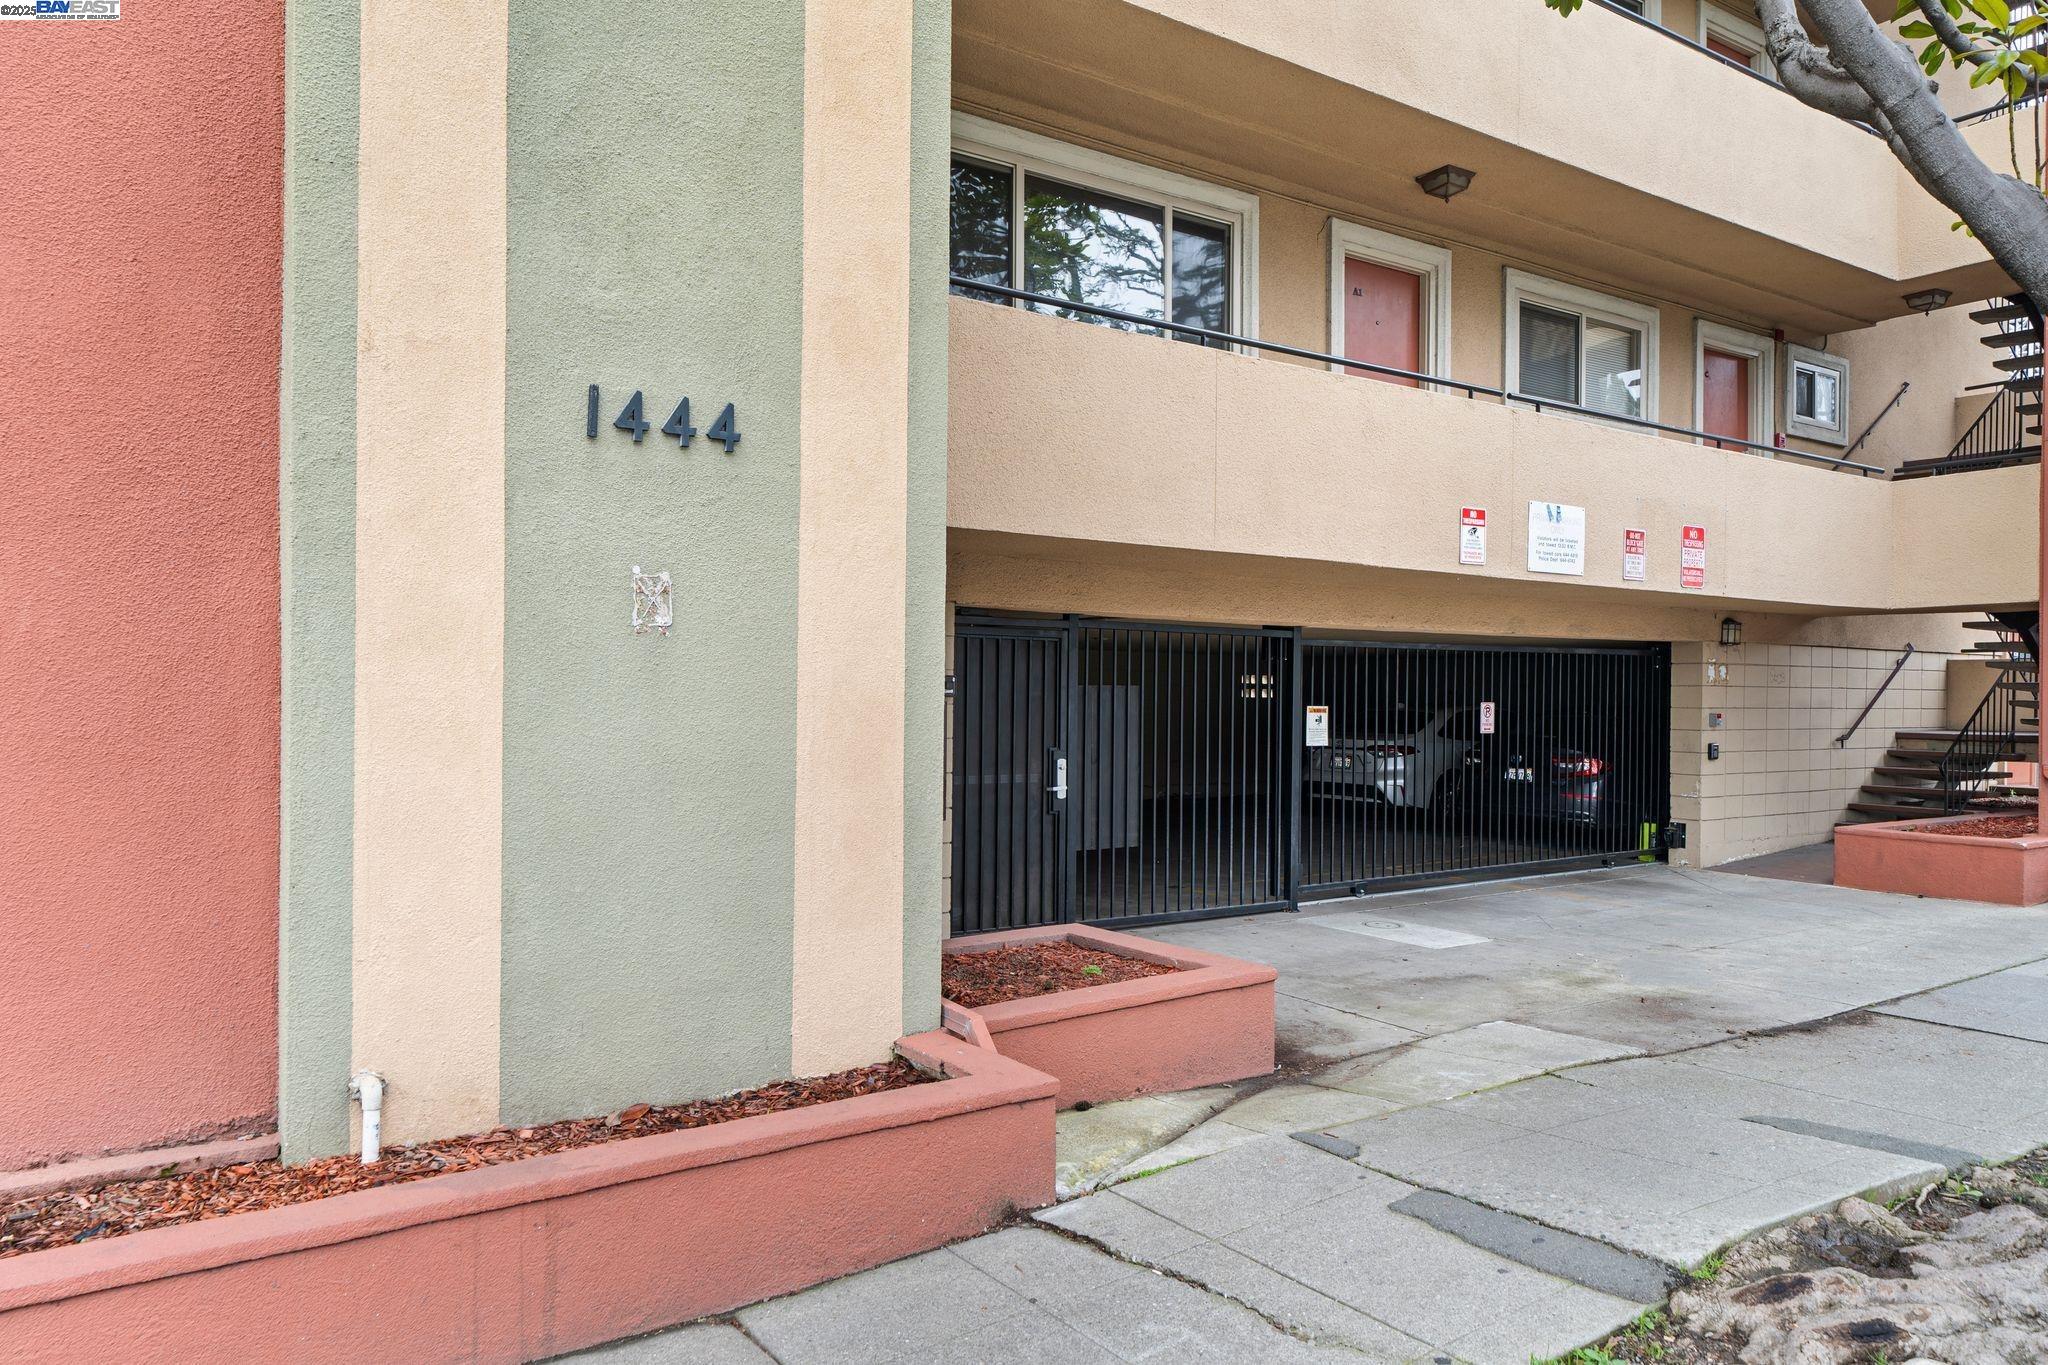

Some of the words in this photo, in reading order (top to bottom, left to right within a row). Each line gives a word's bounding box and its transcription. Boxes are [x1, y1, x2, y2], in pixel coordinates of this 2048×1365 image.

[587, 384, 741, 453] 1444
[1690, 530, 1698, 539] NO
[1684, 549, 1703, 559] PRIVATE
